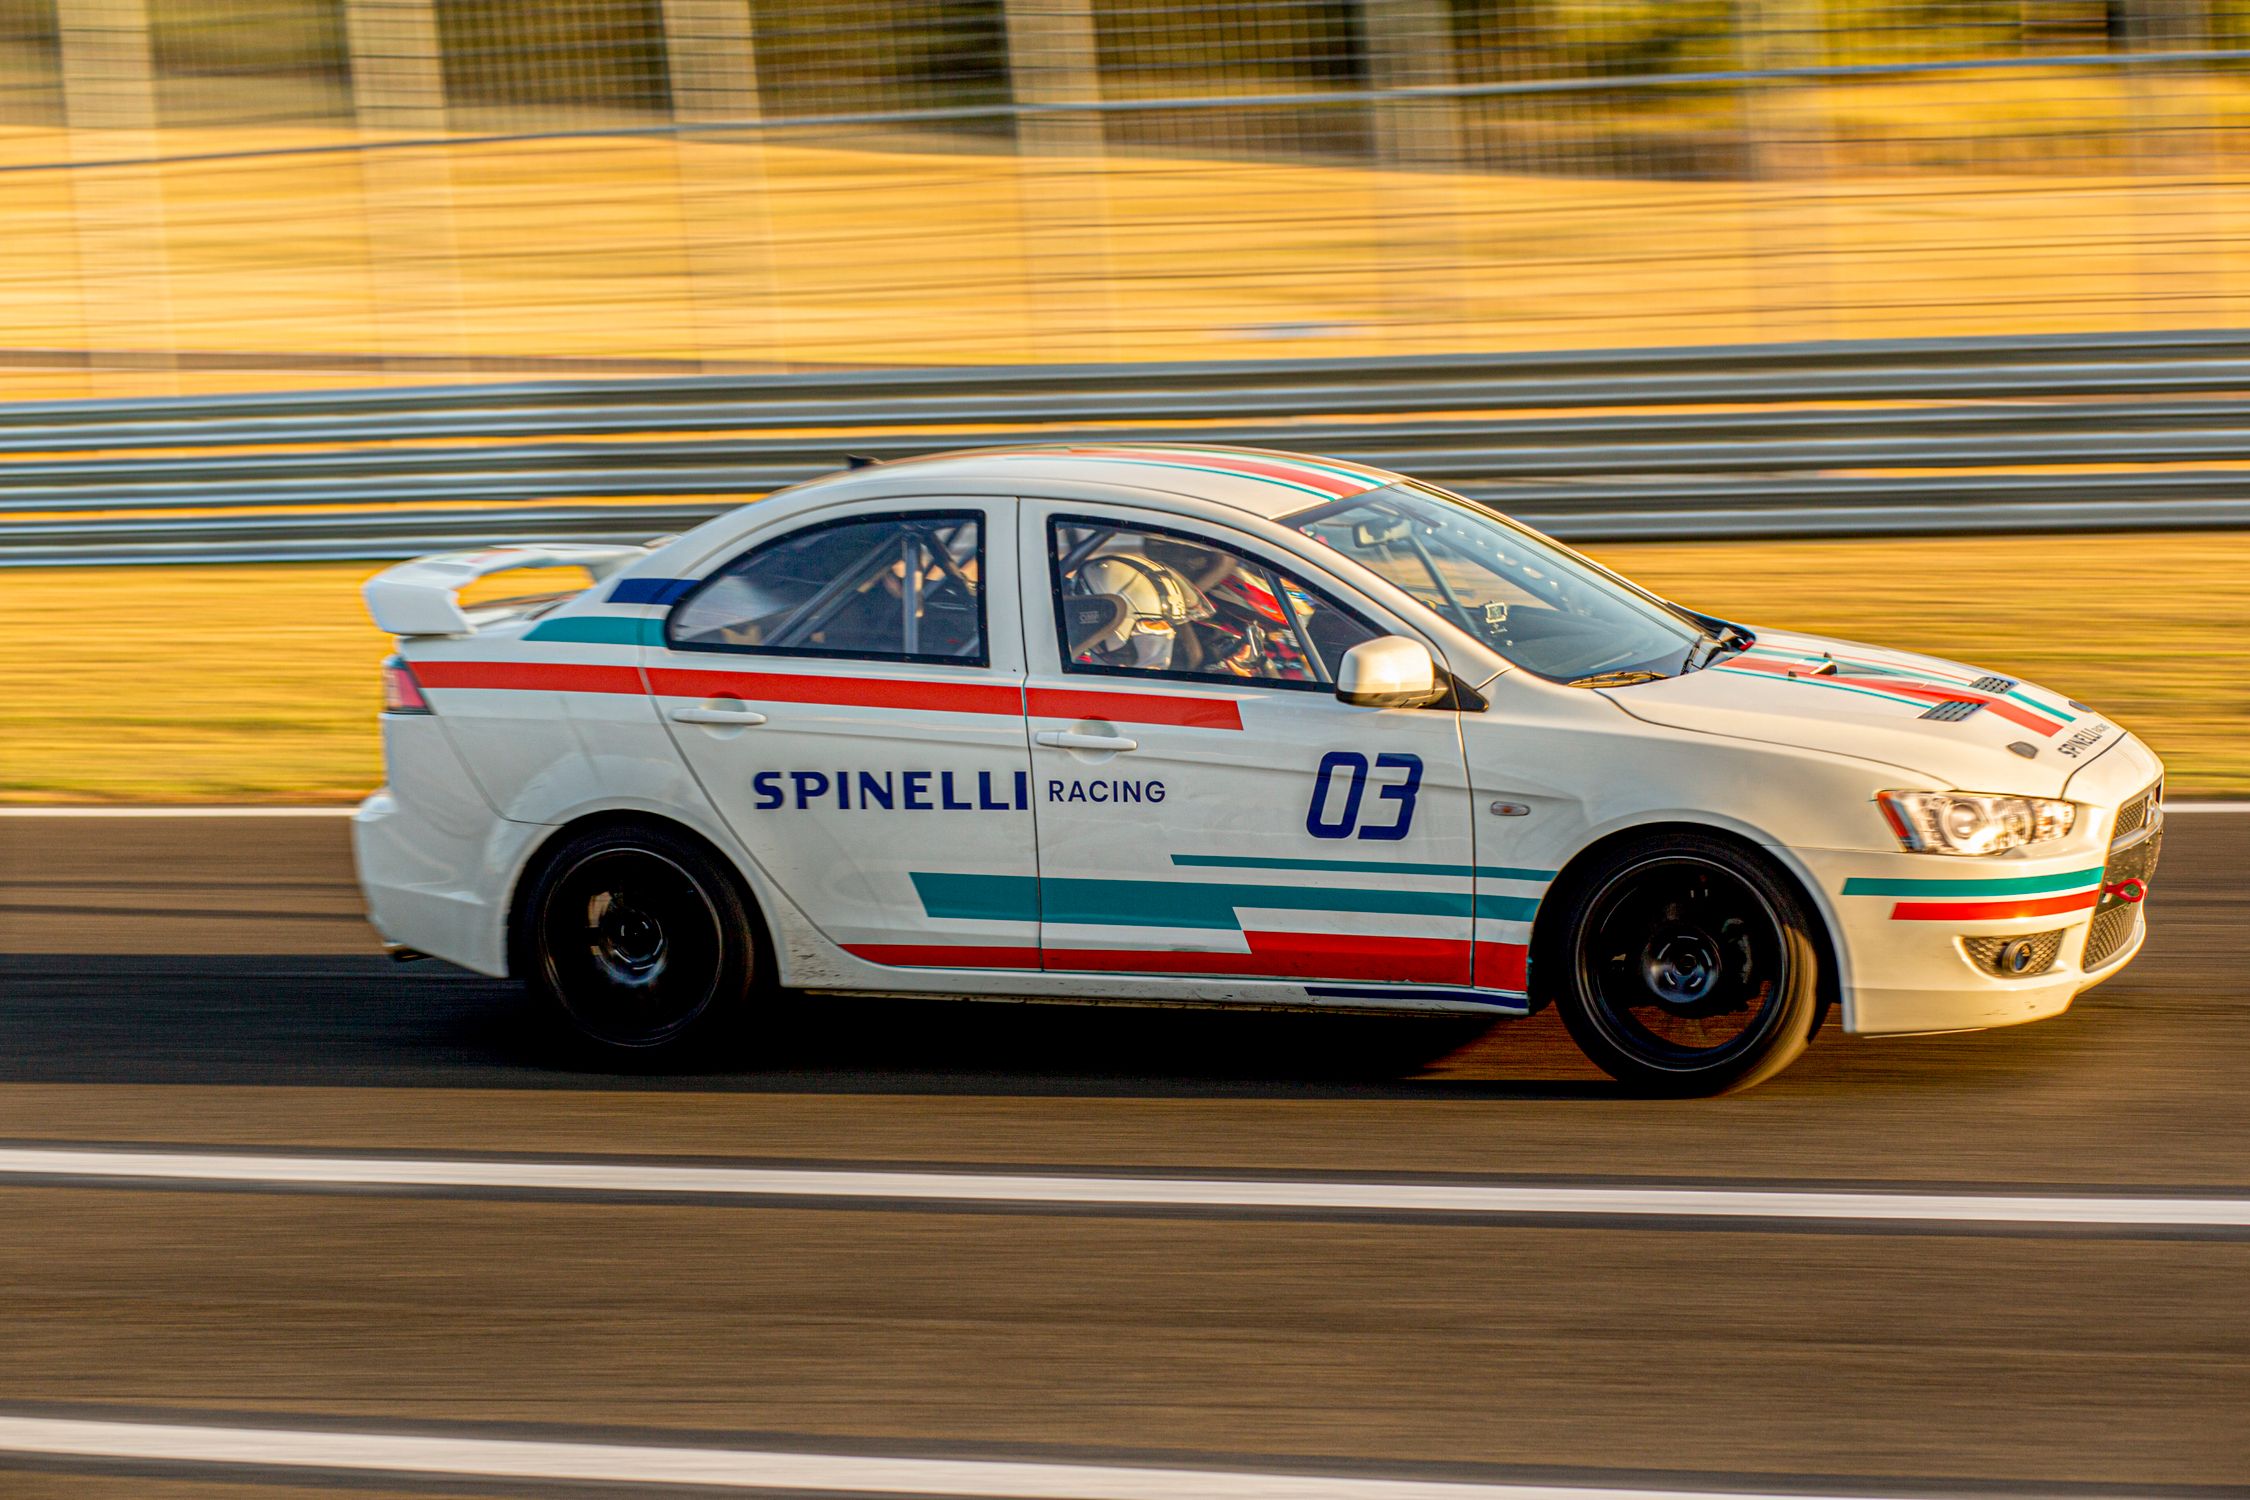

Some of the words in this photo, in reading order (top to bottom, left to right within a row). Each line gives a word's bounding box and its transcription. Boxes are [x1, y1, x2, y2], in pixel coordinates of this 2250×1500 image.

[2057, 728, 2103, 758] SPINELLI
[752, 771, 1027, 811] SPINELLI
[1048, 779, 1167, 804] RACING
[1305, 751, 1424, 841] 03
